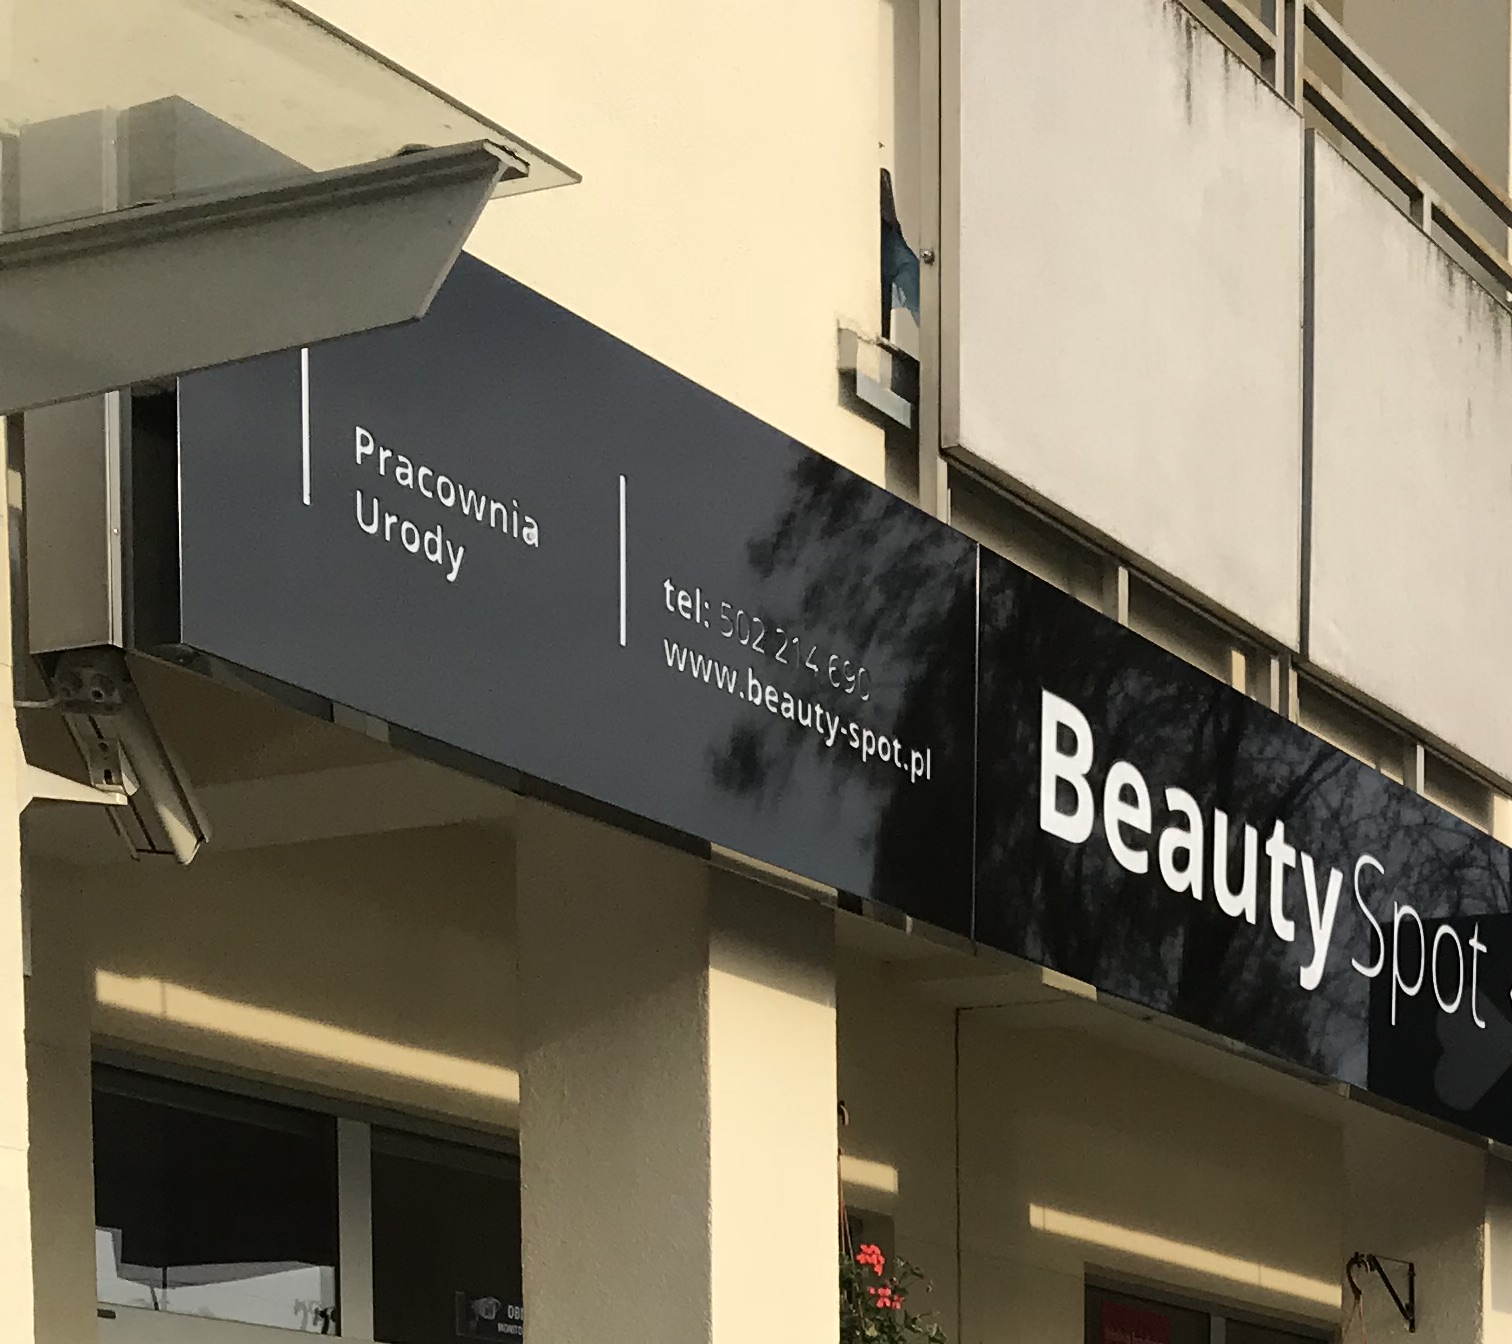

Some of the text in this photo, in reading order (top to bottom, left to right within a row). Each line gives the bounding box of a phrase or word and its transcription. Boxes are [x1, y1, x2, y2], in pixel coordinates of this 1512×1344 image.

[354, 425, 541, 549] Pracownia
[354, 489, 467, 583] Urody
[663, 578, 710, 629] tel:
[720, 601, 765, 654] 502
[774, 627, 820, 677] 214
[663, 638, 931, 783] www.beauty-spot.pl
[1040, 686, 1489, 1029] Beauty Spot
